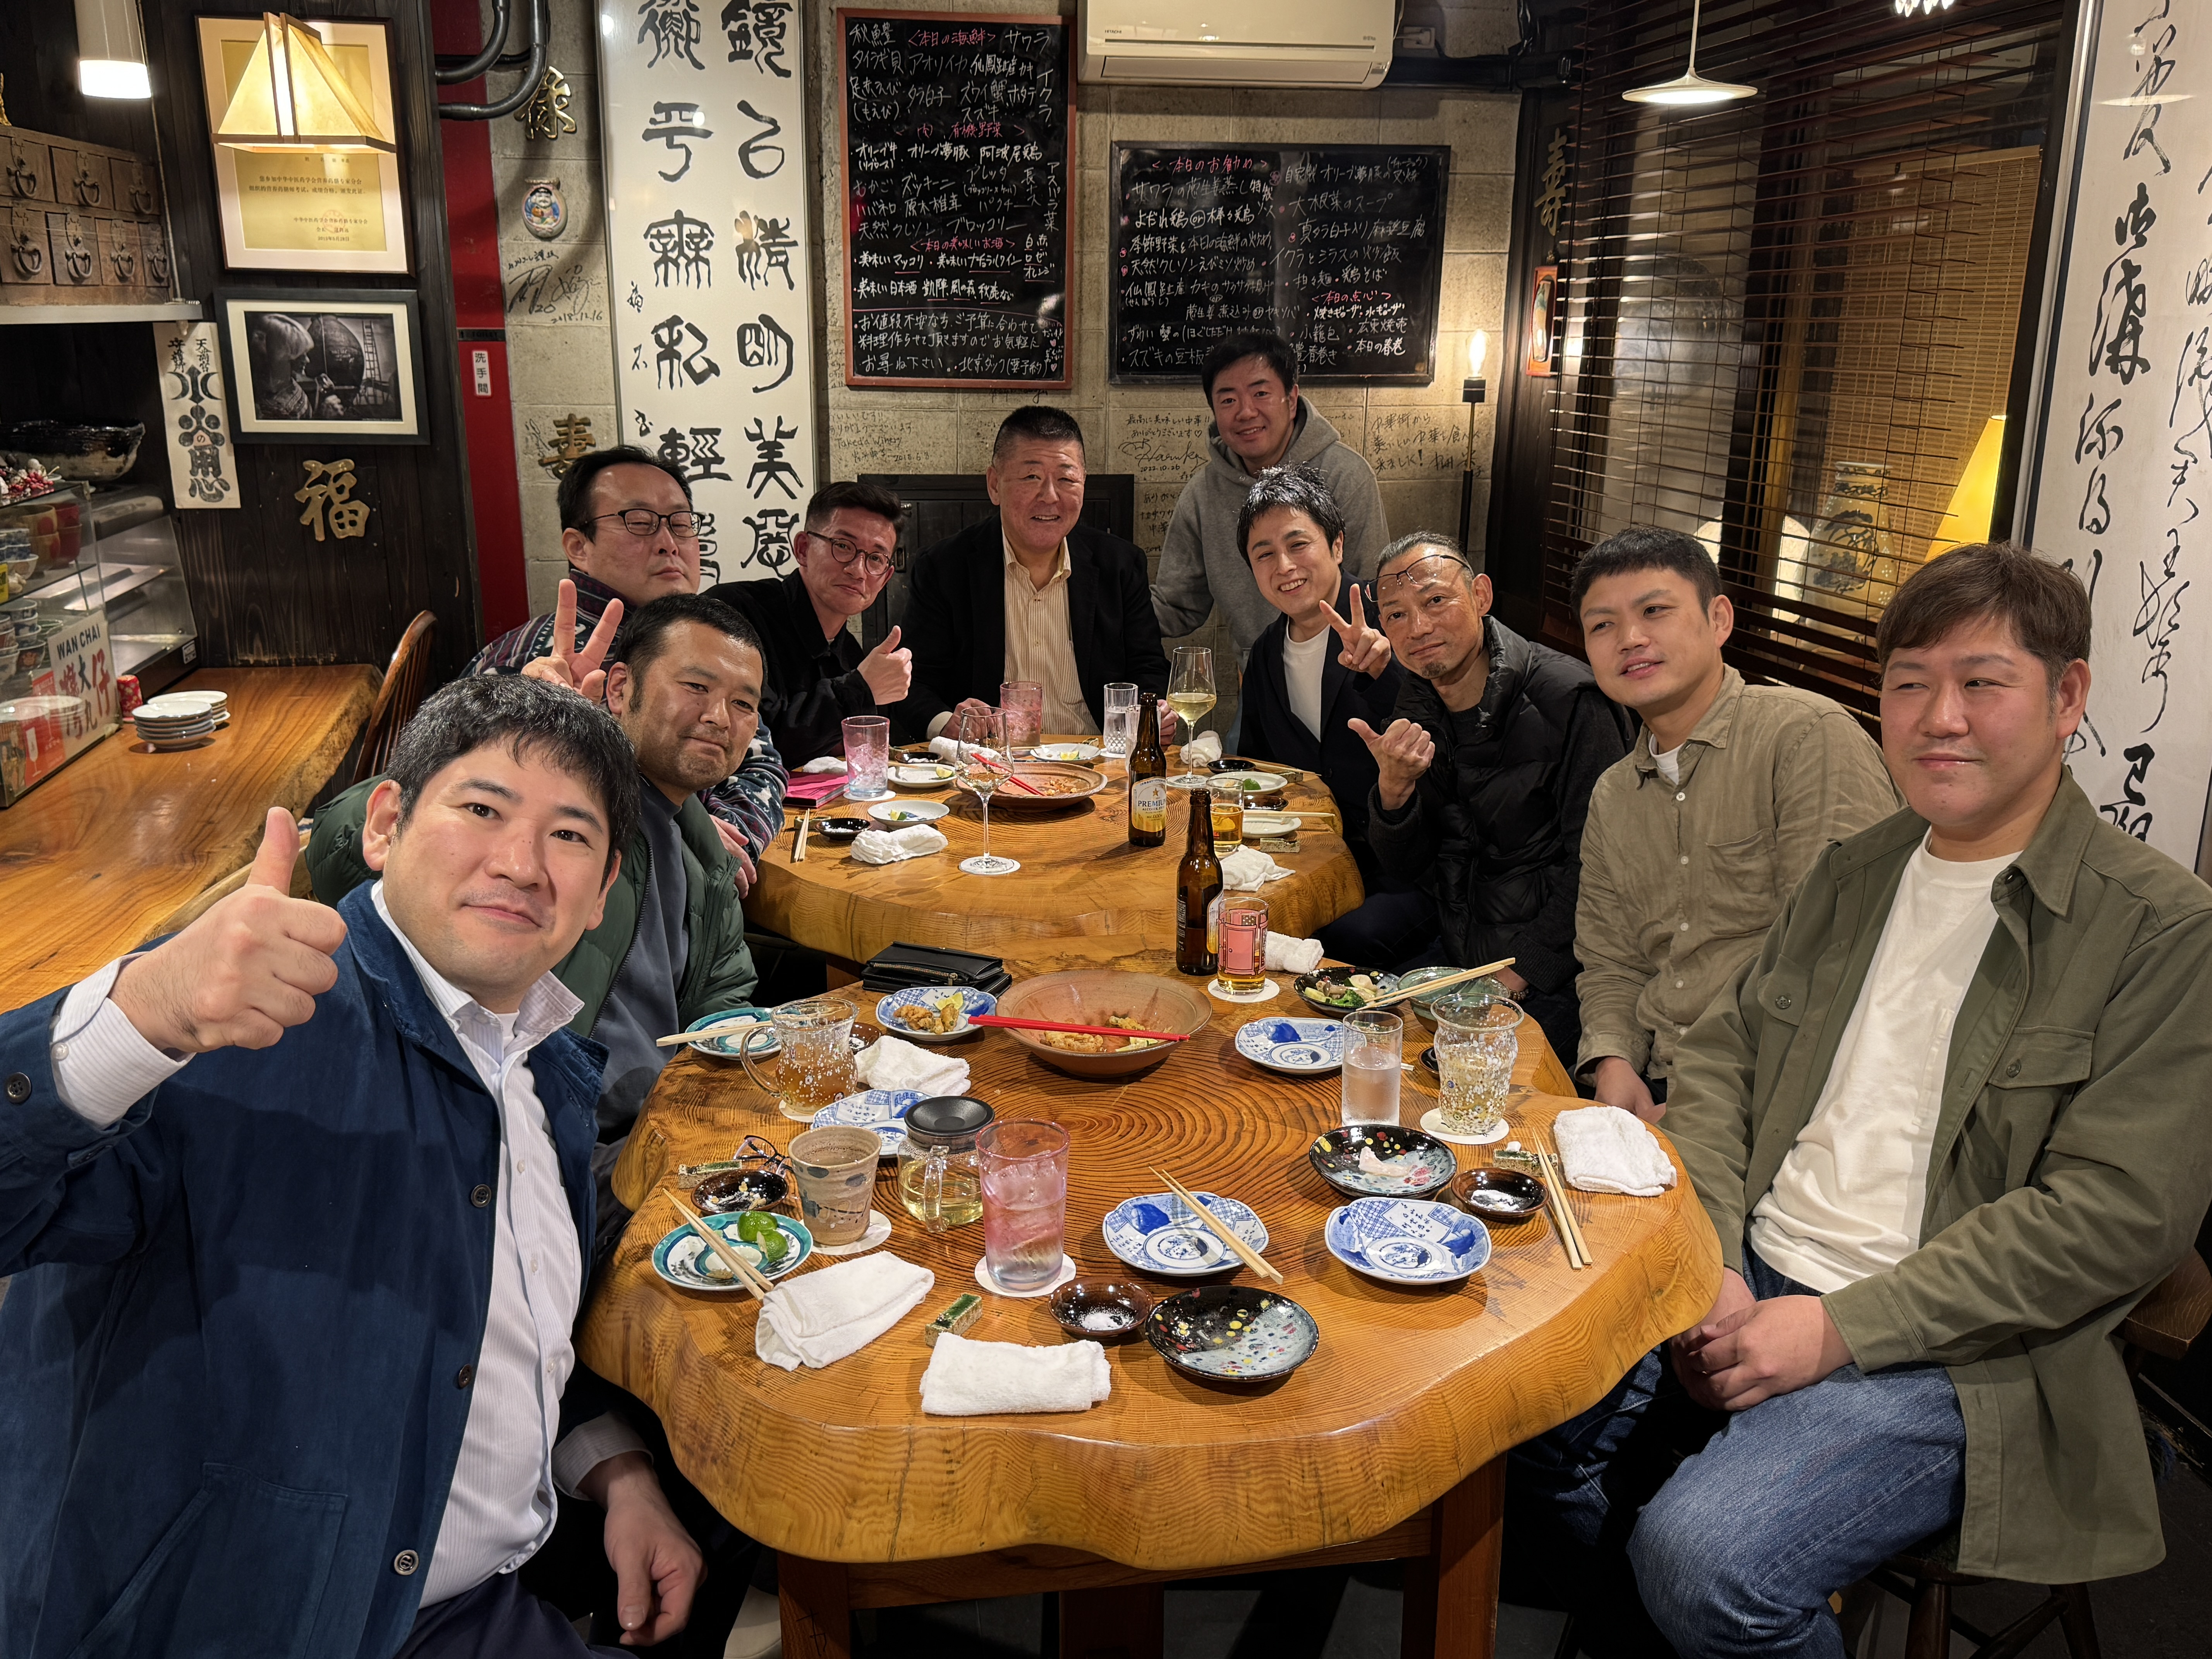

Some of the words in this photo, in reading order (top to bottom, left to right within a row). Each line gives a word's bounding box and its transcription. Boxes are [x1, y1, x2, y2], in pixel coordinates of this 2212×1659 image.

[1005, 30, 1051, 54] サワラ
[909, 53, 968, 77] アオリイカ
[908, 85, 951, 107] タラ白子
[1008, 86, 1036, 106] ホタテ
[962, 105, 1000, 122] スズキ
[902, 173, 956, 198] ズッキーニ
[294, 459, 370, 541] 福
[57, 635, 78, 660] WAN
[79, 623, 100, 647] CHAI
